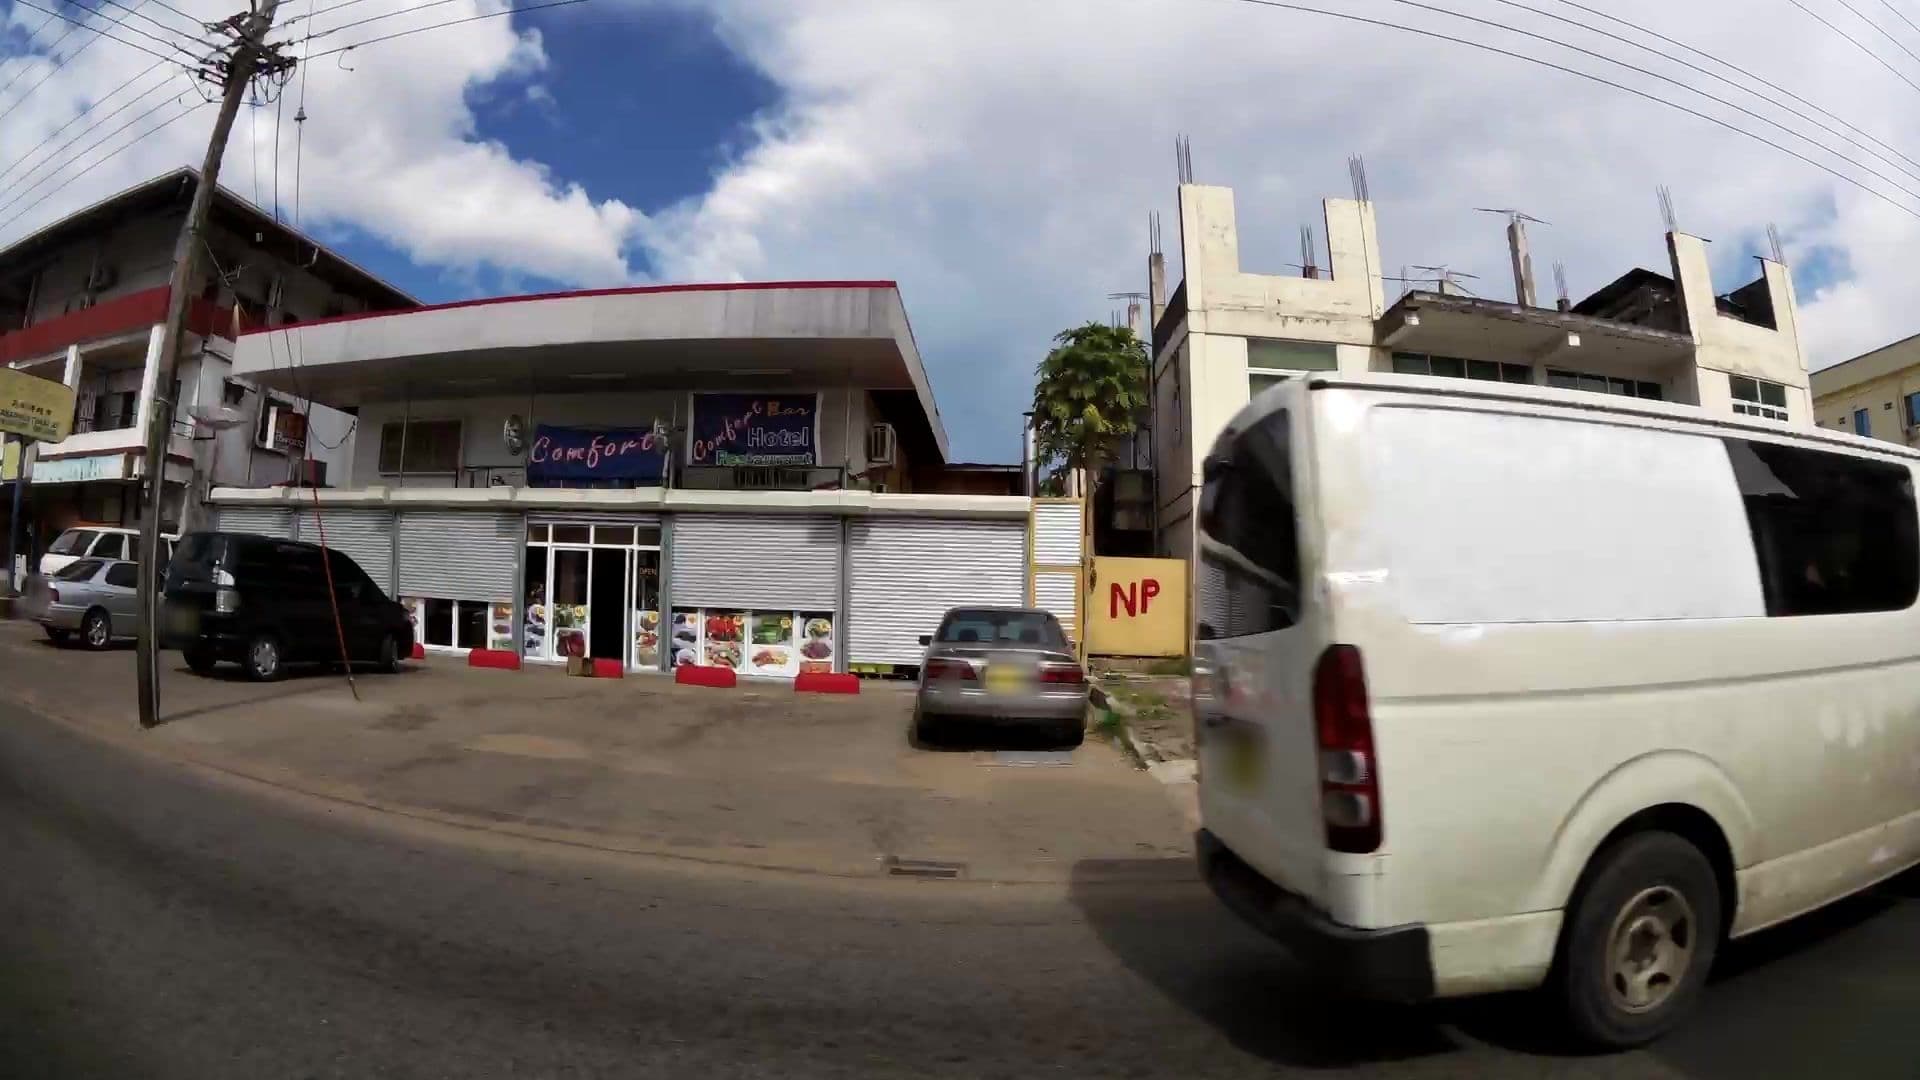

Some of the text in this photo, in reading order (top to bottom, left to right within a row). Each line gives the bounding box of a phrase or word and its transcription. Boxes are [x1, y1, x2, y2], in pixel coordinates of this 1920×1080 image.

[531, 436, 656, 469] Comfort
[747, 426, 809, 447] Hotel
[1110, 578, 1160, 619] NP
